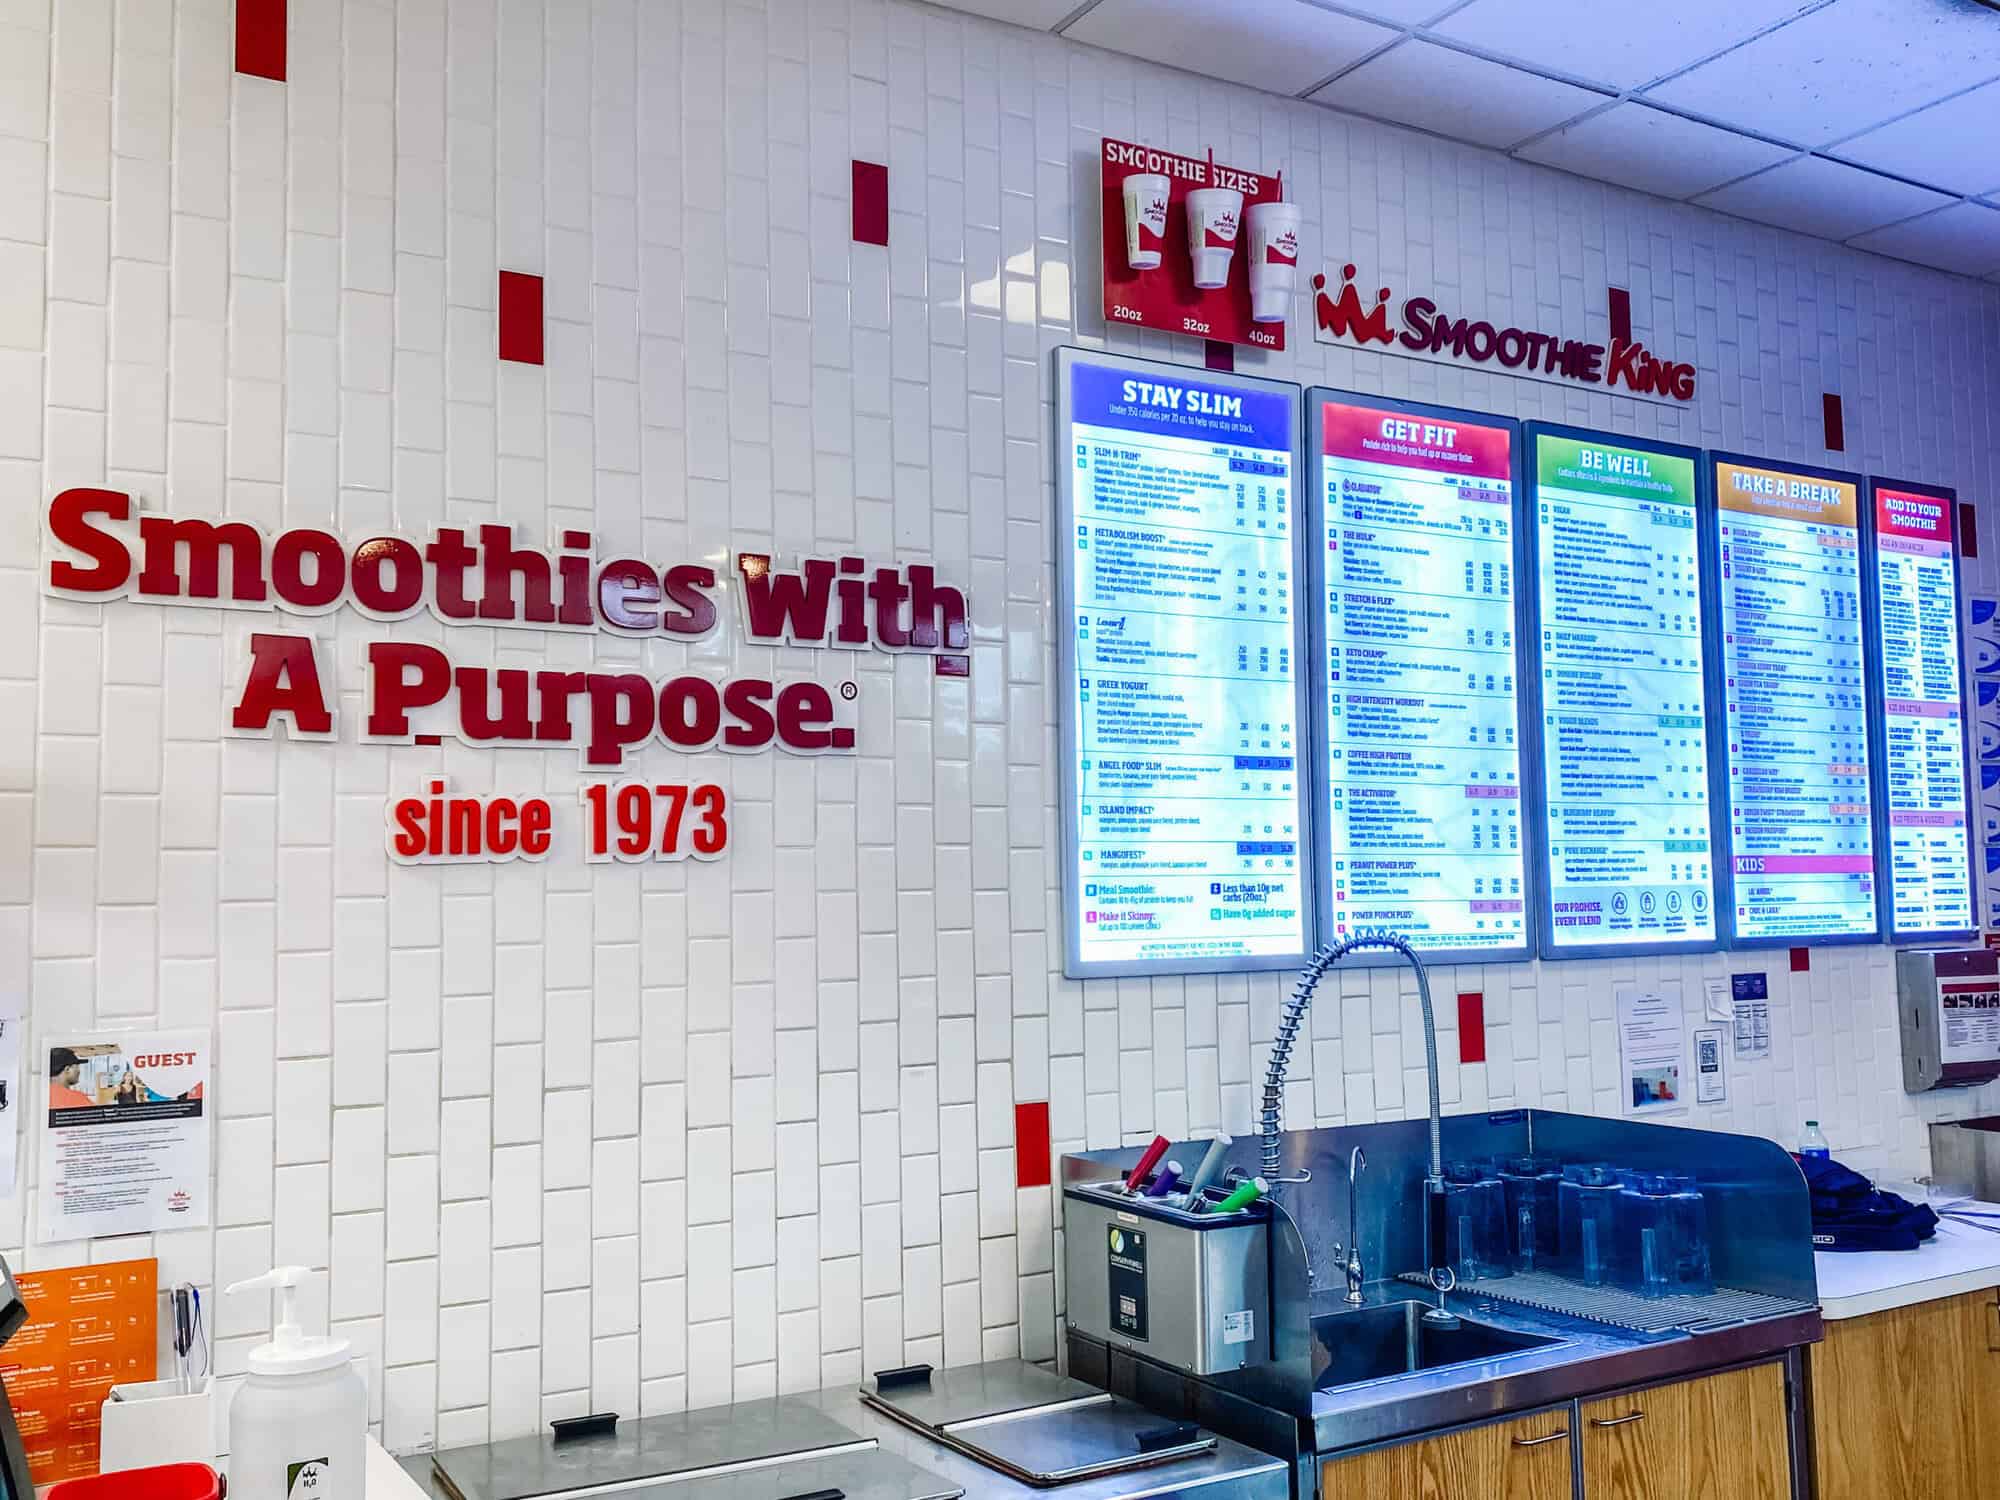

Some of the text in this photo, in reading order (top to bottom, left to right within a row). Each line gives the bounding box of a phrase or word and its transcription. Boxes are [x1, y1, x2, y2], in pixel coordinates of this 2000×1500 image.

[1106, 143, 1206, 183] SMOOTHIE
[1114, 305, 1142, 320] 20oz
[1183, 318, 1210, 333] 32oz
[1249, 330, 1275, 344] 40oz
[1400, 297, 1604, 383] SMOOTHIE
[1123, 380, 1242, 418] STAY SLIM
[1109, 404, 1127, 416] Under
[1138, 408, 1160, 421] calories
[1161, 412, 1170, 423] per
[1188, 415, 1194, 424] to
[1195, 416, 1208, 428] help
[1209, 420, 1219, 431] you
[1382, 418, 1456, 447] GET FIT
[1094, 447, 1112, 458] SLIM
[1581, 450, 1651, 477] BE WELL
[1732, 472, 1773, 495] TAKE
[1776, 478, 1787, 496] A
[1790, 481, 1841, 505] BREAK
[1885, 498, 1942, 517] ADD TO YOUR
[1891, 514, 1936, 530] SMOOTHIE
[1095, 528, 1140, 542] METABOLISM
[48, 487, 717, 638] Smoothies
[740, 553, 970, 650] With
[231, 634, 333, 733] A
[1097, 680, 1148, 691] GREEK YOGURT
[1098, 761, 1120, 770] ANGEL
[1145, 761, 1162, 771] SLIM
[1099, 805, 1125, 814] ISLAND
[394, 781, 727, 857] since 1973
[1736, 858, 1765, 872] KIDS
[1099, 884, 1155, 895] Meal Smoothie:
[1223, 883, 1283, 895] Less than 10g net
[1223, 893, 1267, 904] carbs (20oz.)
[1223, 909, 1240, 918] Have
[1252, 908, 1273, 918] added
[1275, 908, 1296, 918] sugar
[1554, 903, 1569, 913] OUR
[1099, 912, 1119, 921] Make
[1127, 911, 1156, 923] Skinny:
[1555, 917, 1576, 926] EVERY
[134, 1052, 196, 1068] GUEST
